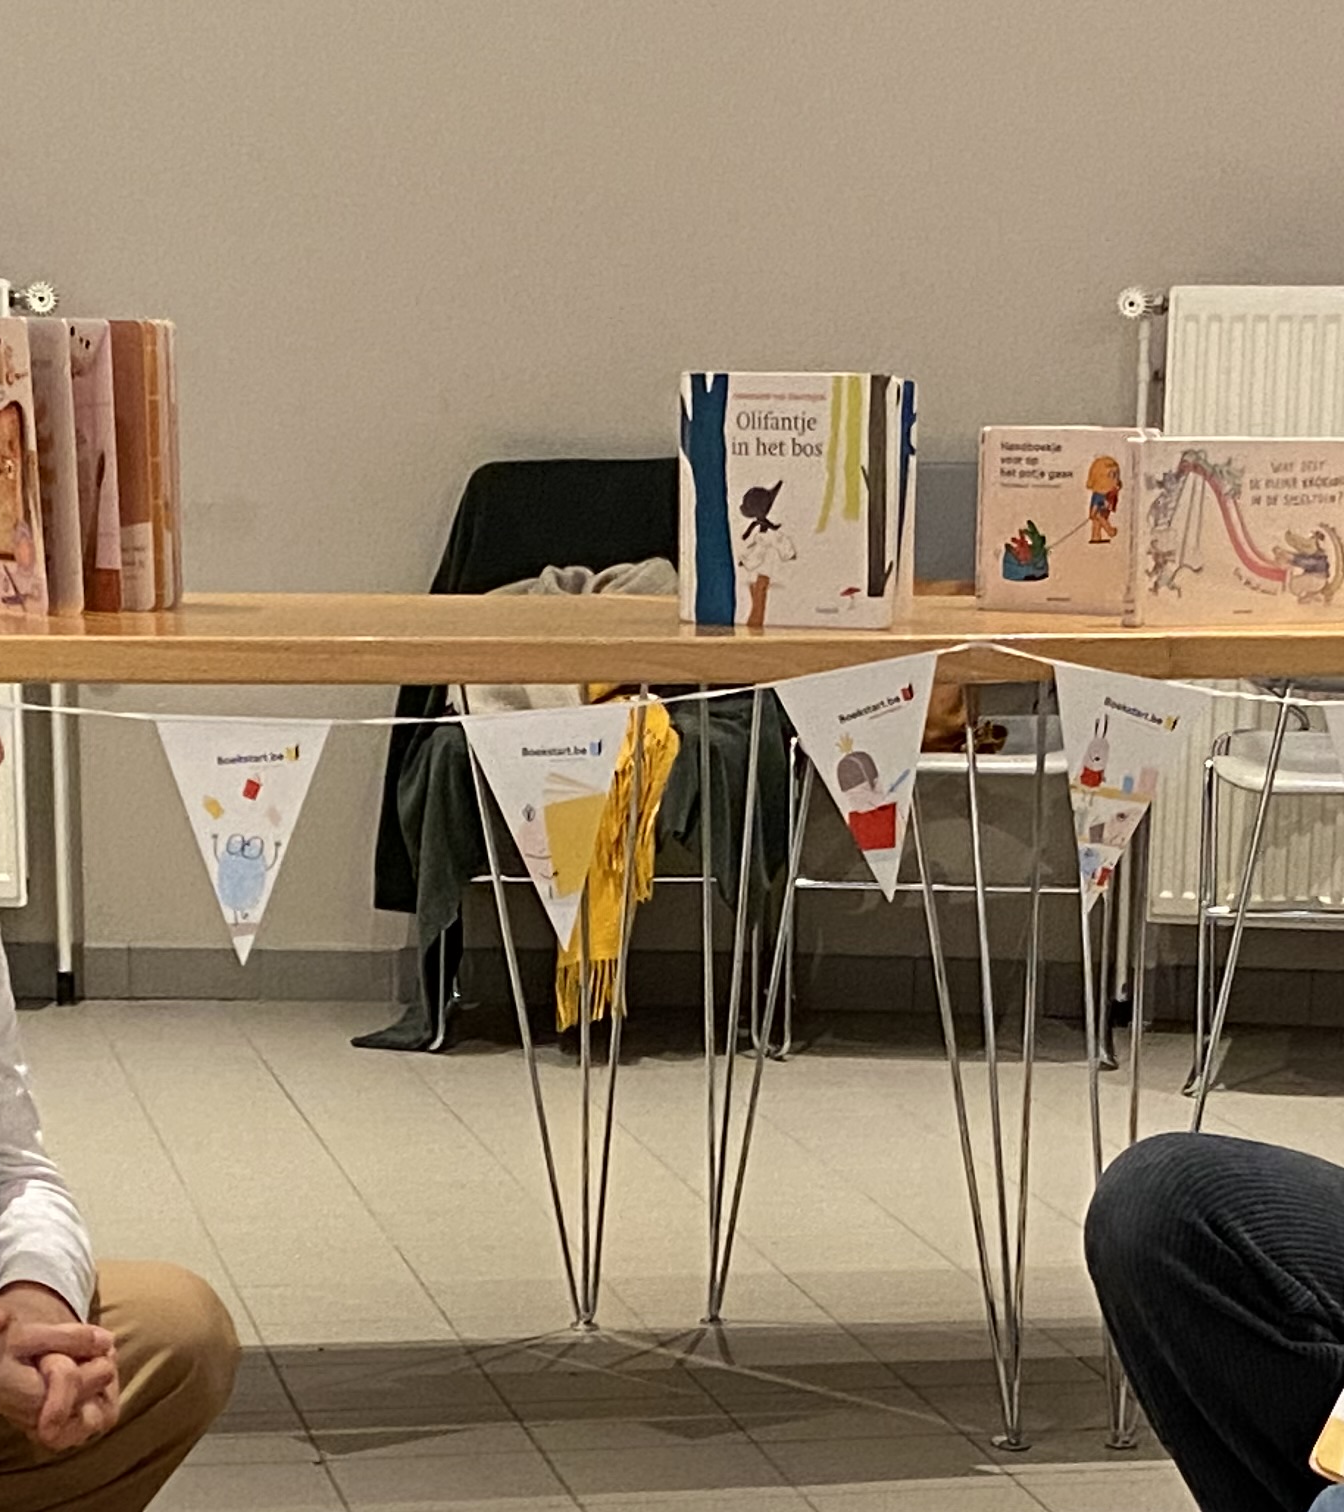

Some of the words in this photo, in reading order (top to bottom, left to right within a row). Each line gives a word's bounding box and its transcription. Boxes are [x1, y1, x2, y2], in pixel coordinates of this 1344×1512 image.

[736, 411, 817, 436] Olifantje
[732, 438, 749, 456] in
[756, 437, 785, 456] het
[792, 437, 823, 457] bos
